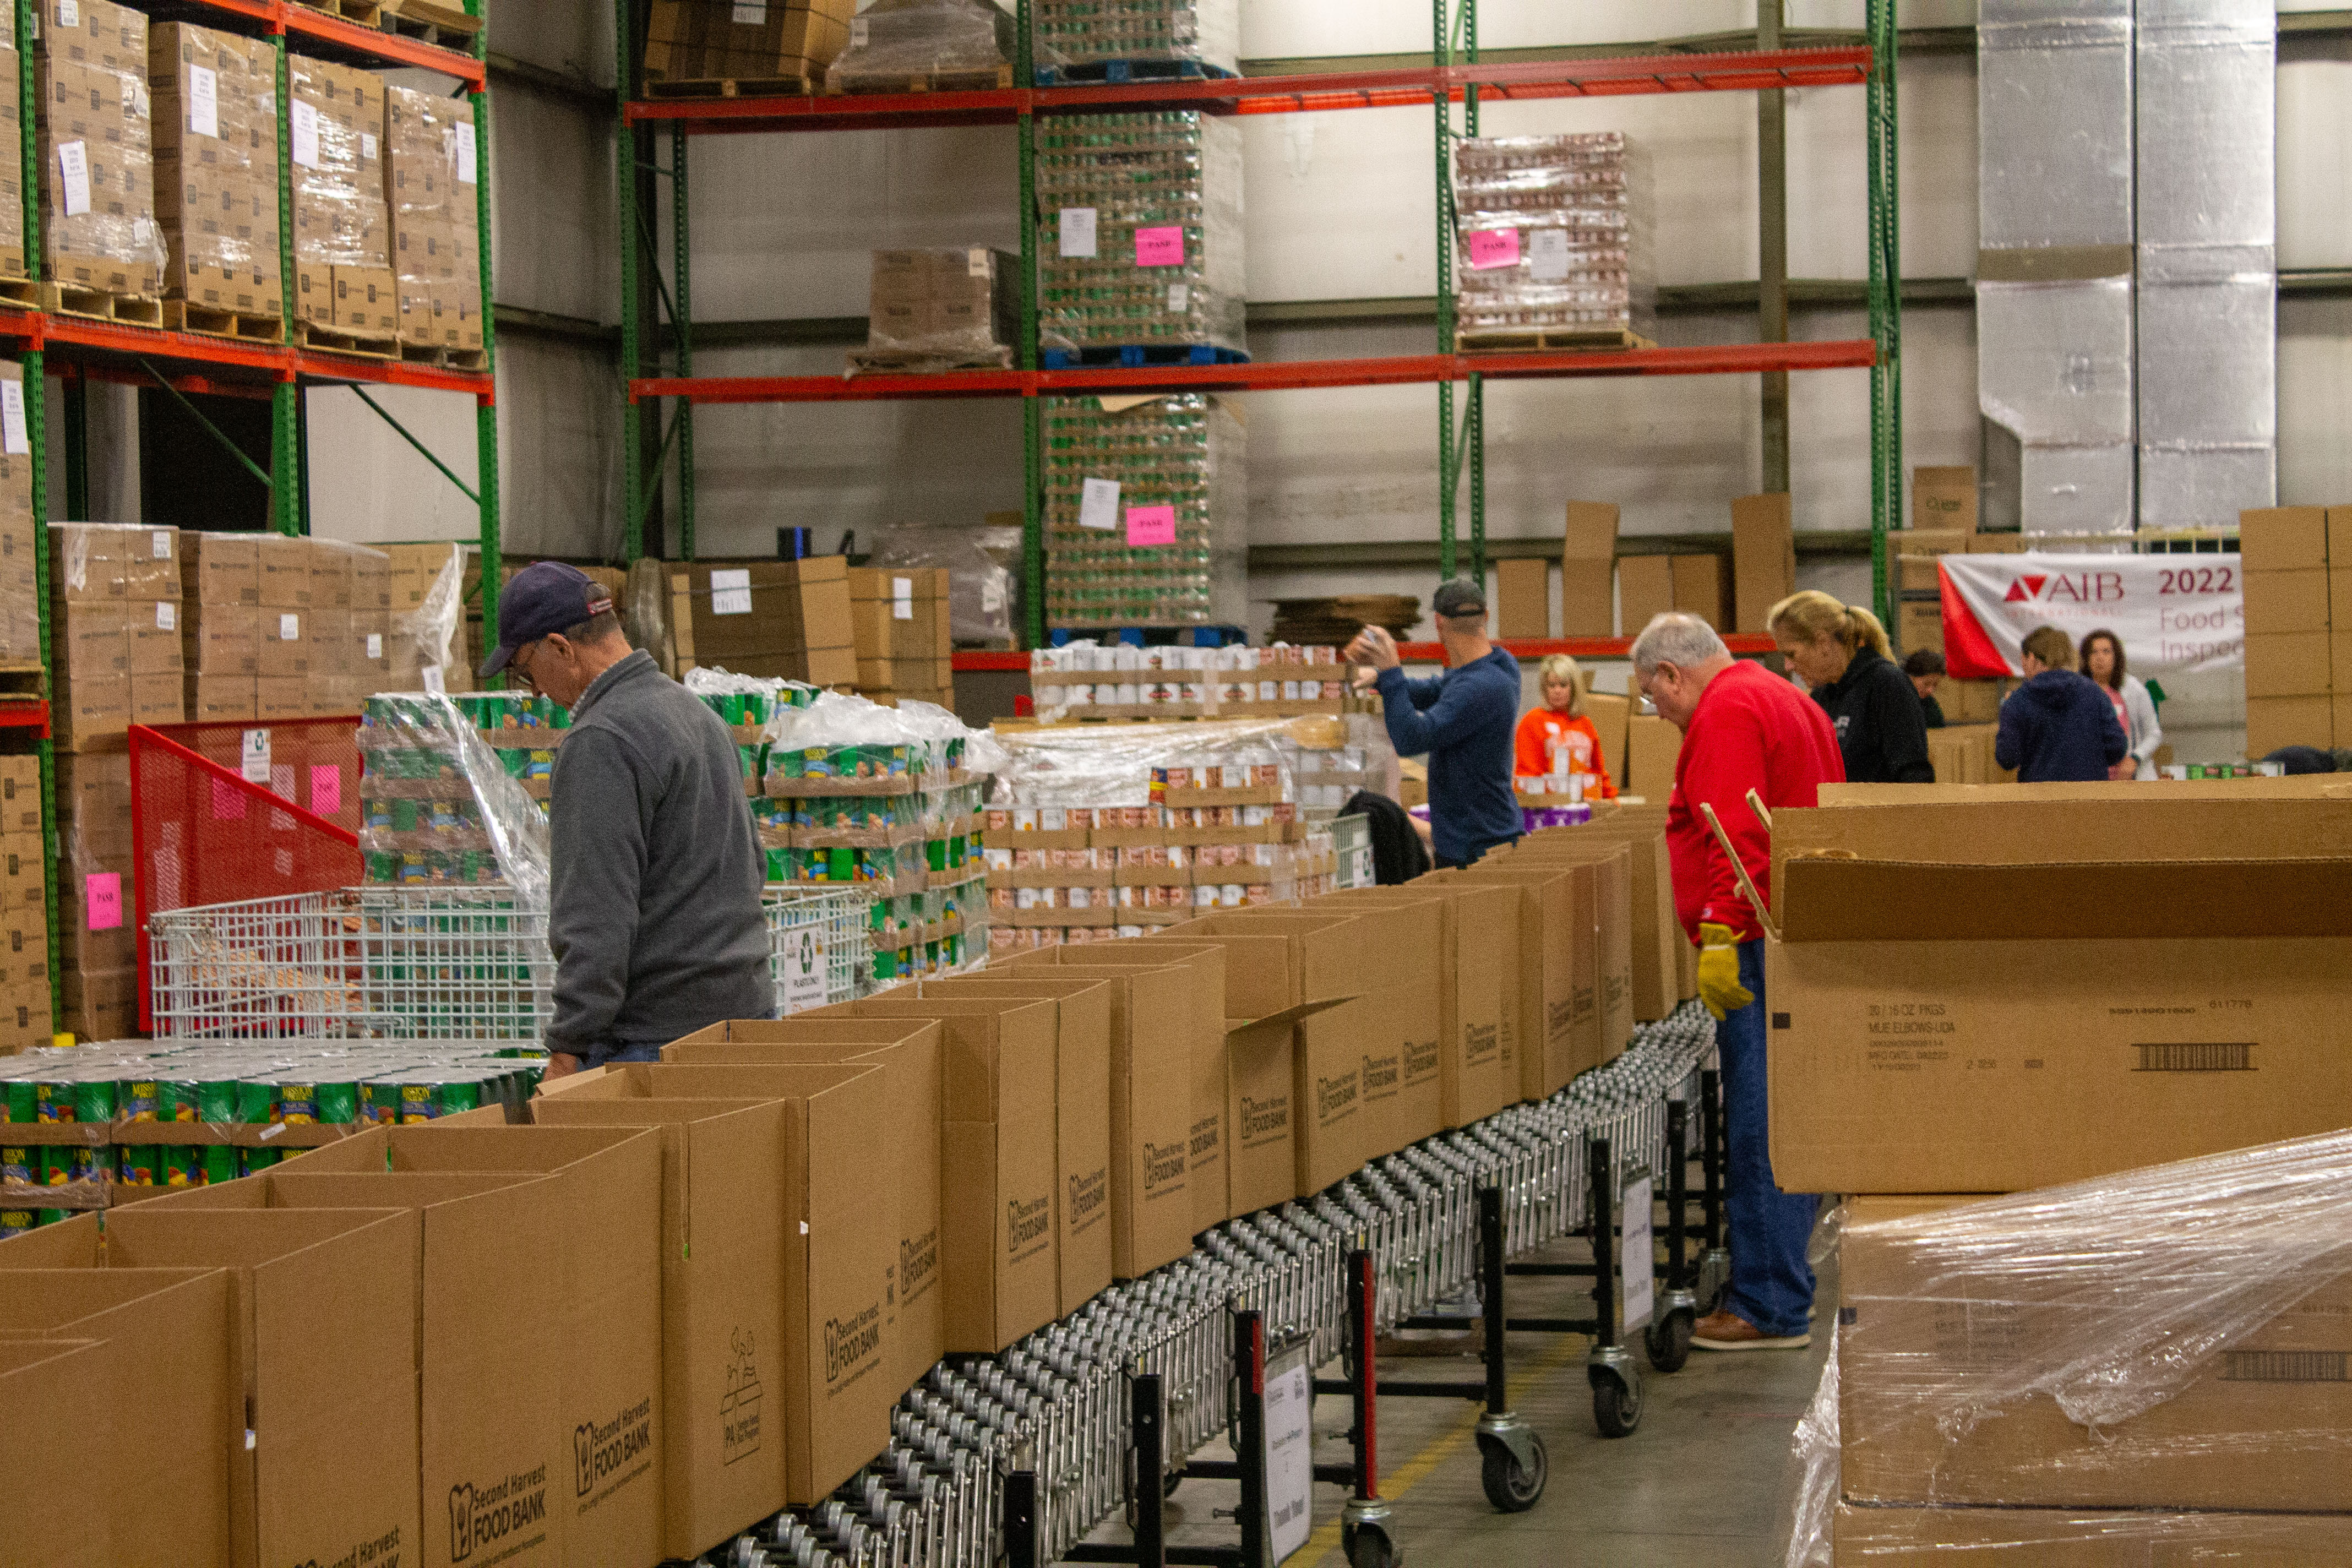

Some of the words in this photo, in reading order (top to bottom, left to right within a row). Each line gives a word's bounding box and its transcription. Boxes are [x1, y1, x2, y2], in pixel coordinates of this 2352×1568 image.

[2048, 573, 2125, 602] AIB
[2159, 567, 2234, 596] 2022
[2162, 606, 2225, 630] Food
[1253, 1113, 1270, 1134] FOOD
[1271, 1109, 1287, 1129] BANK
[1155, 1161, 1170, 1183] FOOD
[1170, 1156, 1185, 1178] BANK
[1019, 1218, 1034, 1245] FOOD
[1035, 1211, 1049, 1237] BANK
[837, 1313, 858, 1342] Second
[859, 1300, 879, 1327] Harvest
[839, 1336, 859, 1370] FOOD
[861, 1322, 880, 1356] BANK
[594, 1410, 621, 1447] Second
[622, 1396, 650, 1429] Harvest
[594, 1439, 622, 1481] FOOD
[624, 1419, 651, 1461] BANK
[474, 1474, 508, 1511] Second
[511, 1461, 546, 1496] Harvest
[474, 1505, 511, 1548] FOOD
[512, 1488, 546, 1531] BANK
[360, 1523, 400, 1566] Harvest
